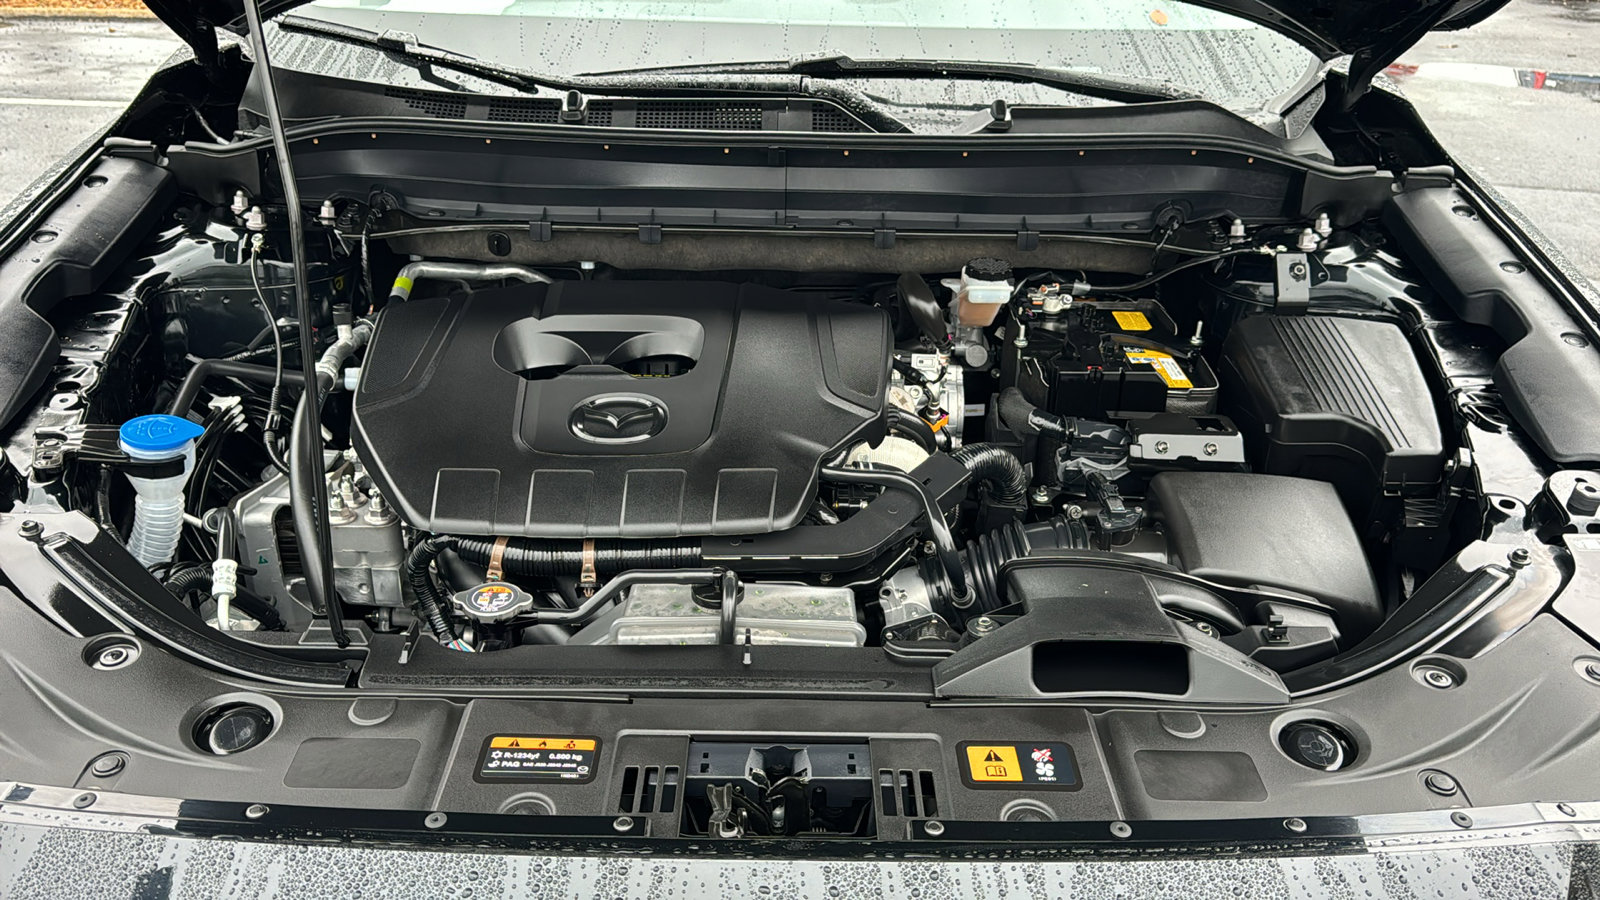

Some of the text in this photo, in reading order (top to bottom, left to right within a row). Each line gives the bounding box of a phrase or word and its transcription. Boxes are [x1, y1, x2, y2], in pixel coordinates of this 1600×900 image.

[503, 751, 540, 760] R-1234yf
[572, 753, 583, 762] kg
[501, 760, 520, 768] PAG
